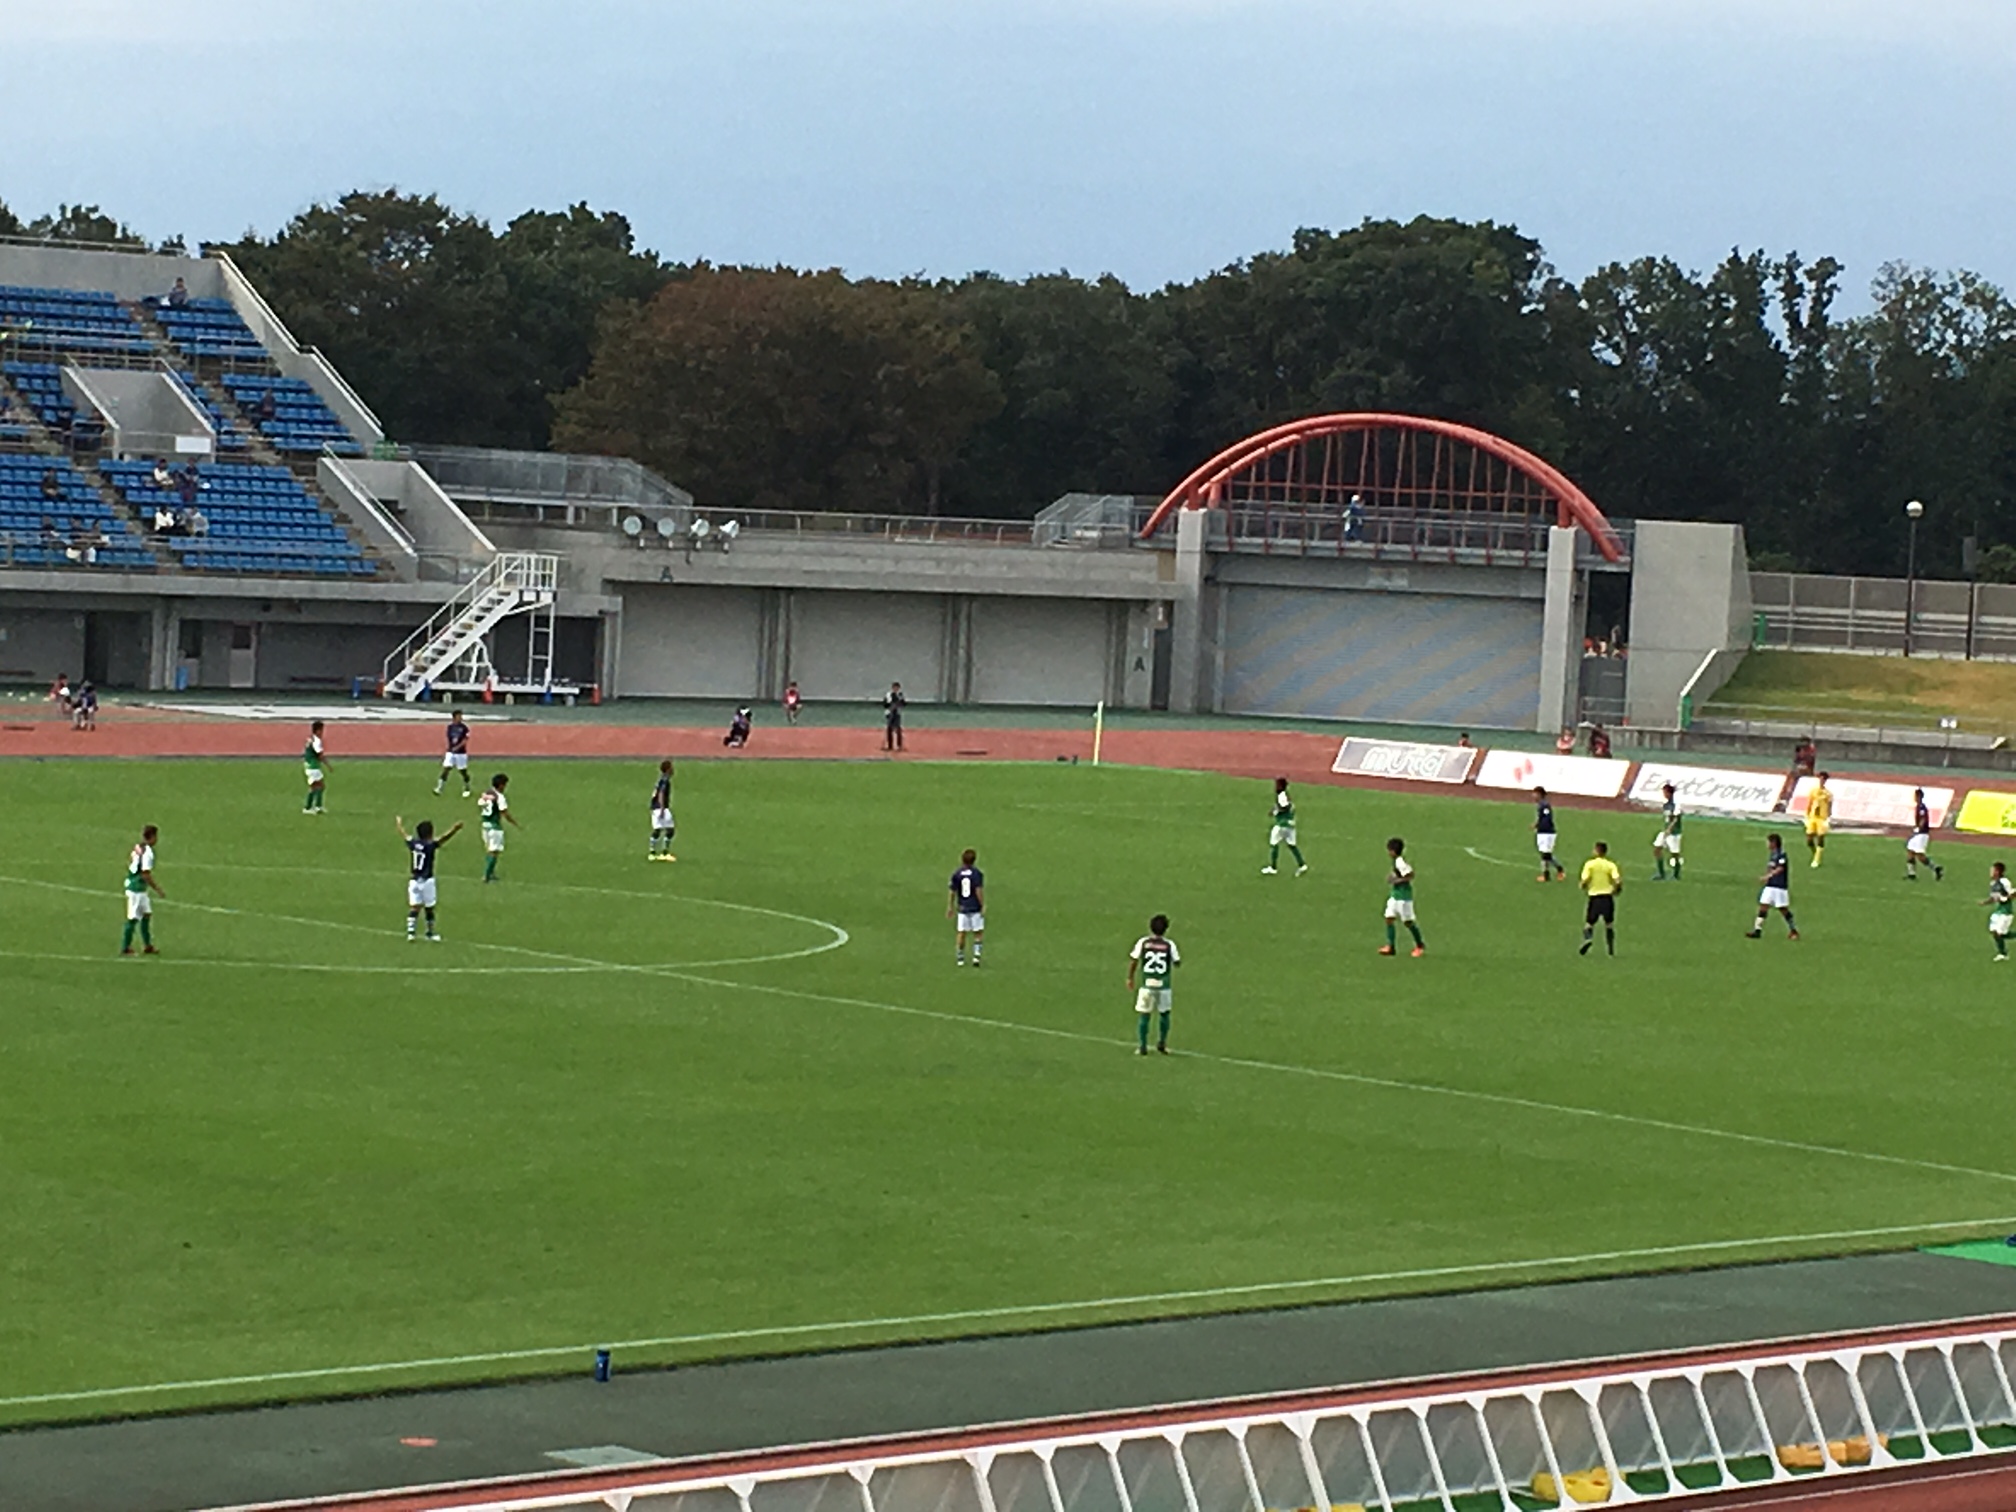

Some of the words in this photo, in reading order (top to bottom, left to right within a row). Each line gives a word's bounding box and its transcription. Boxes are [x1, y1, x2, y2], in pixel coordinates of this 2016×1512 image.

[1133, 656, 1145, 672] A
[412, 850, 426, 870] 17
[961, 877, 971, 898] 8
[1143, 951, 1167, 974] 25
